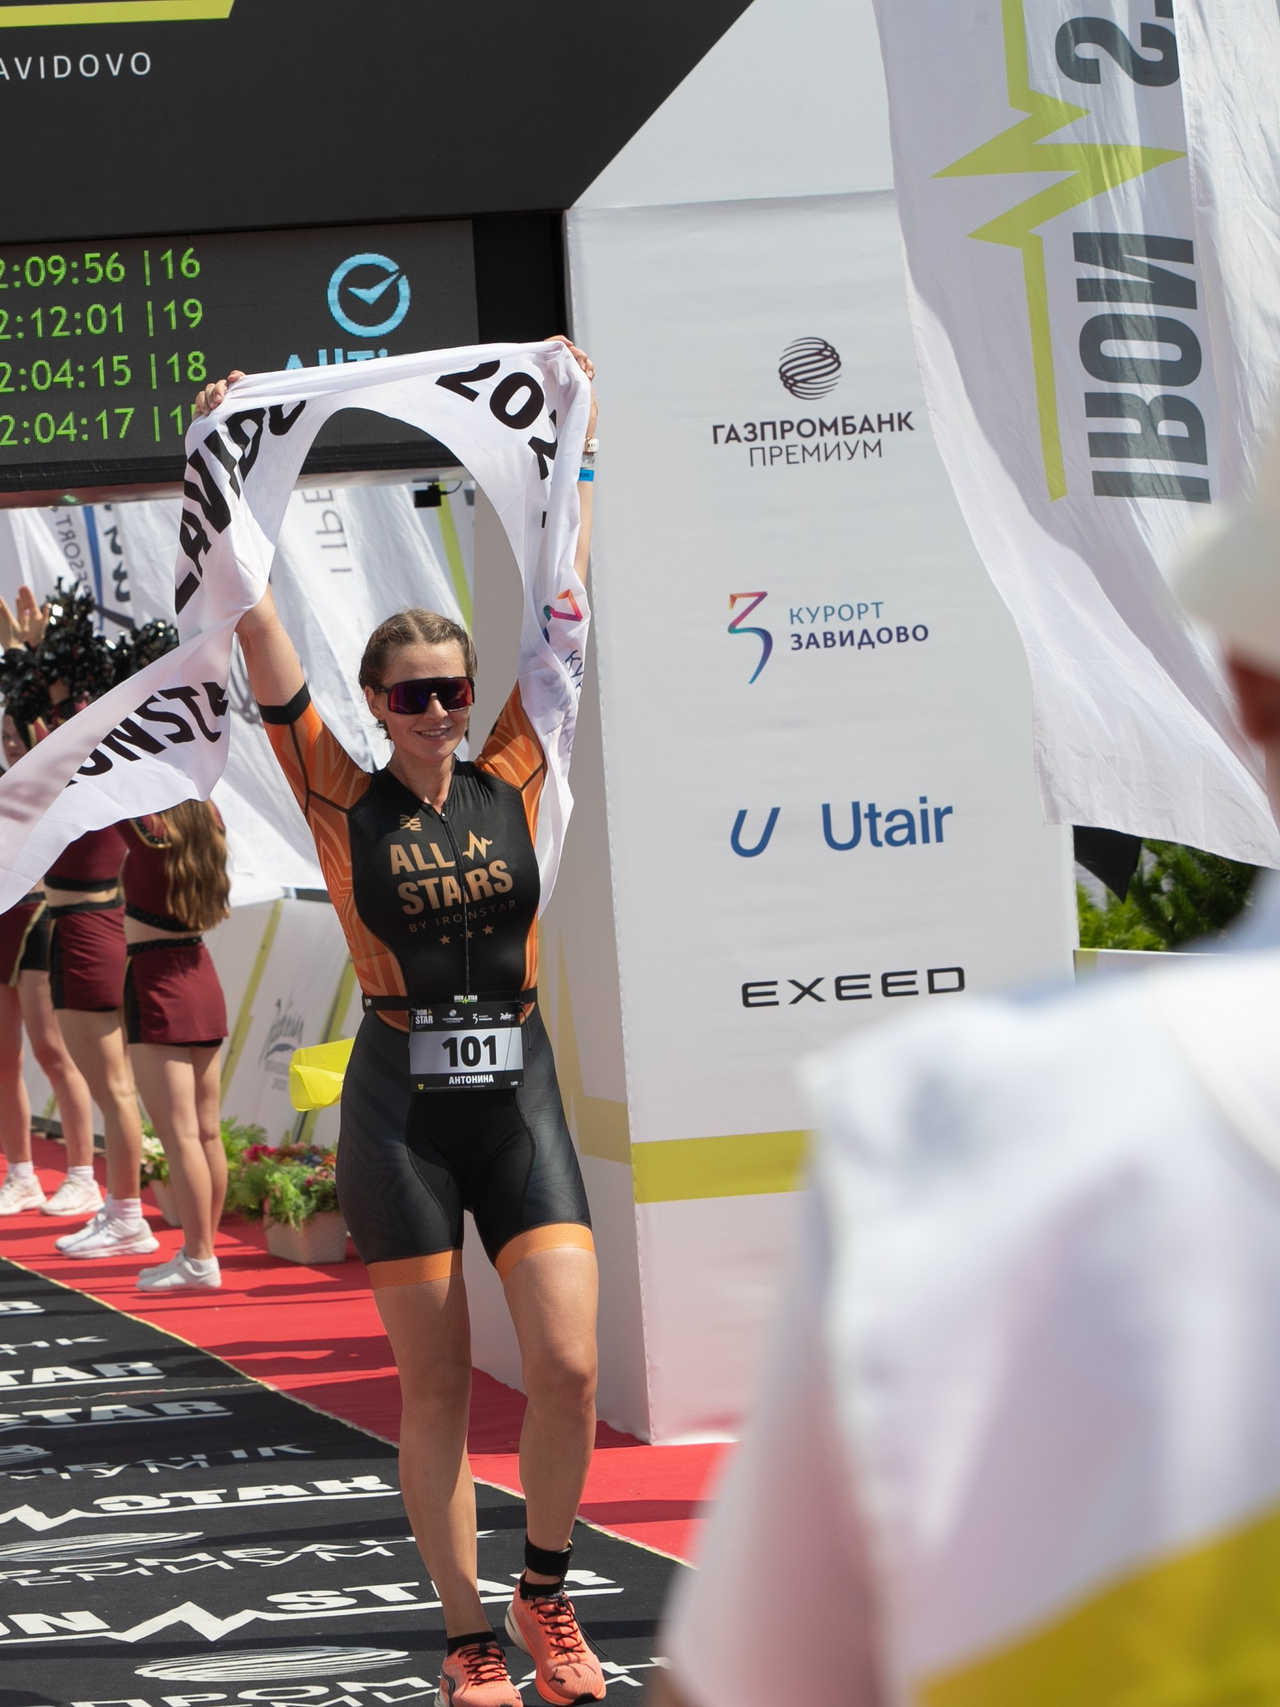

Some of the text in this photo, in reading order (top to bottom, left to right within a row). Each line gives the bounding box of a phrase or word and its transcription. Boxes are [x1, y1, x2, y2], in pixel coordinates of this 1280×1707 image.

[153, 404, 196, 443] |1
[711, 411, 915, 445] ГАЗПРОМБАНК
[435, 360, 558, 528] 202
[749, 439, 883, 467] ПРЕМИУМ
[789, 601, 884, 625] КУРОРТ
[790, 624, 929, 651] ЗАВИДОВО
[821, 796, 954, 851] Utair
[389, 842, 456, 875] ALL
[397, 860, 514, 915] STARS
[409, 900, 517, 934] BY IRONSTAR
[741, 966, 965, 1008] EXEED
[415, 1016, 433, 1024] STAR
[441, 1035, 497, 1067] 101
[449, 1074, 494, 1085] АНТОНИНА
